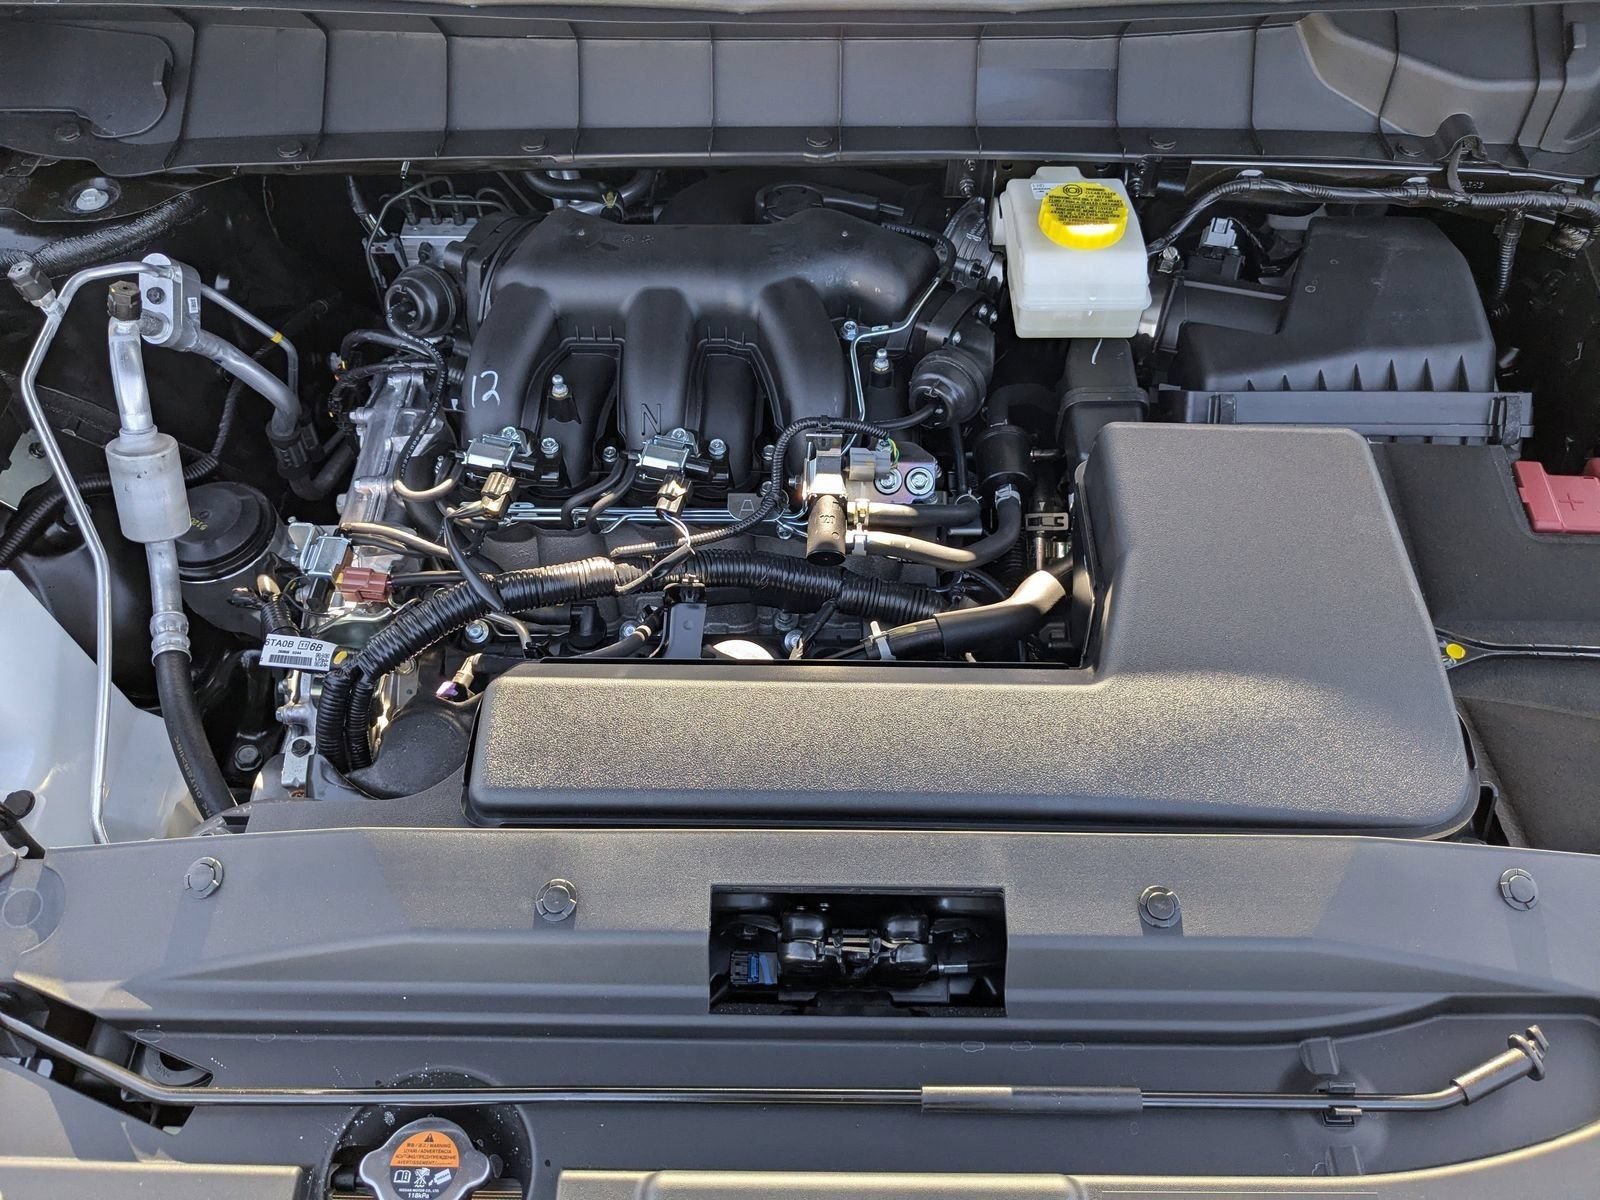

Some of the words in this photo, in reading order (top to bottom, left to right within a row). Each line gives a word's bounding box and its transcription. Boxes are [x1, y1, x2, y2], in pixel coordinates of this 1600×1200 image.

[471, 370, 501, 409] 12
[640, 403, 662, 436] N
[309, 643, 324, 652] 6B
